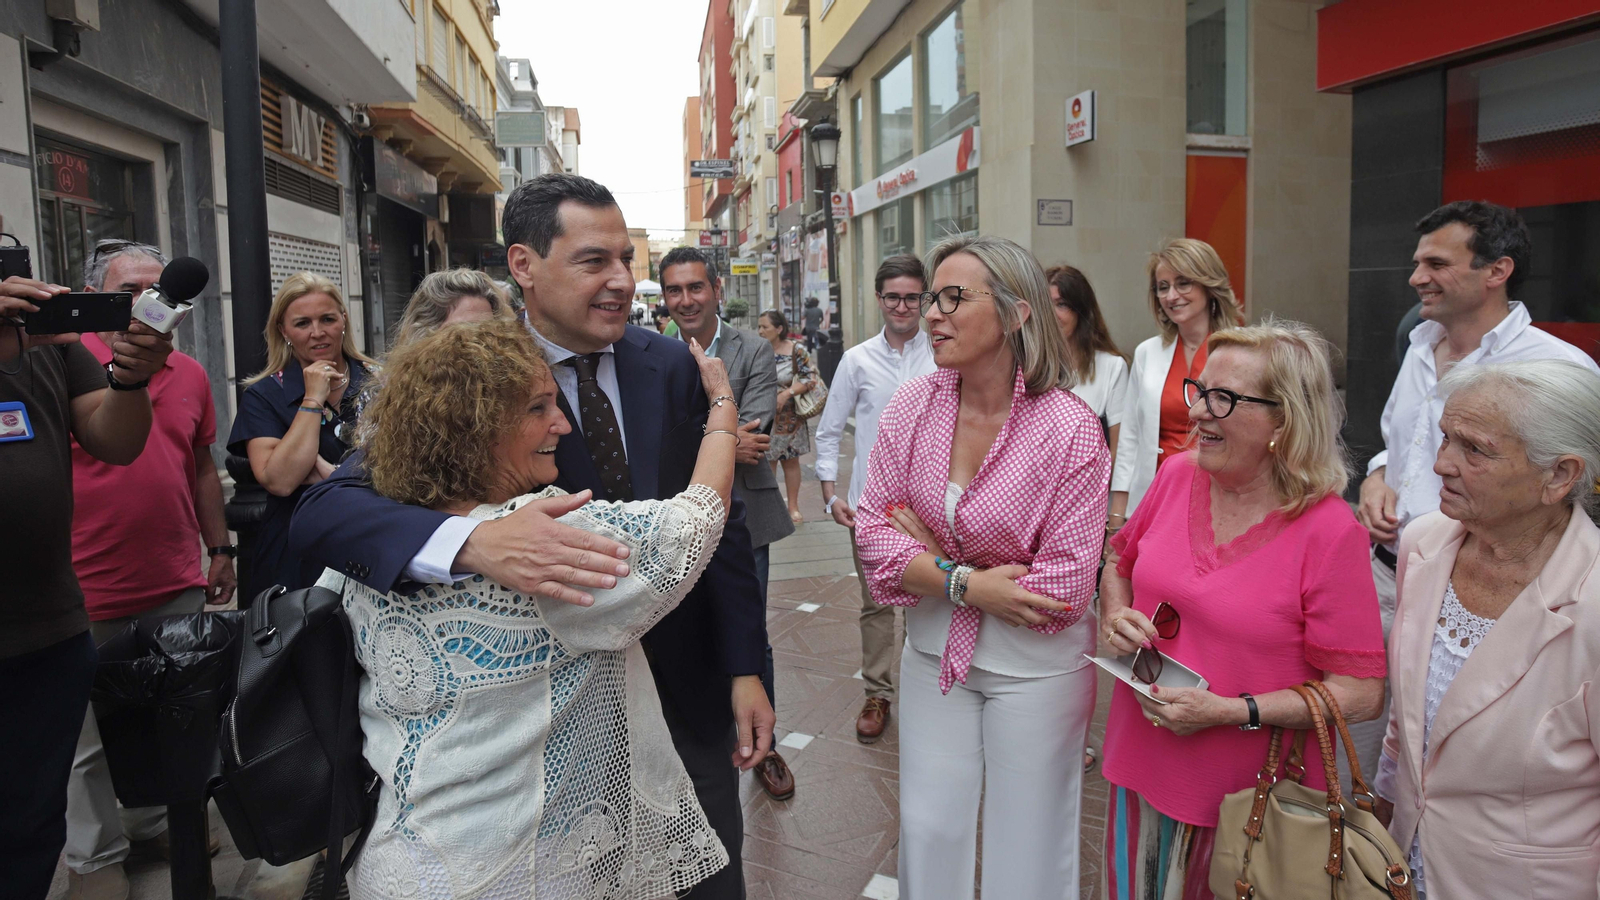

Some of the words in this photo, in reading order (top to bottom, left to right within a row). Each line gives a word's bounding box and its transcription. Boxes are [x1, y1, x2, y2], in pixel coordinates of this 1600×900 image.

[284, 96, 325, 167] MY
[1067, 118, 1087, 131] General
[61, 173, 72, 187] 14
